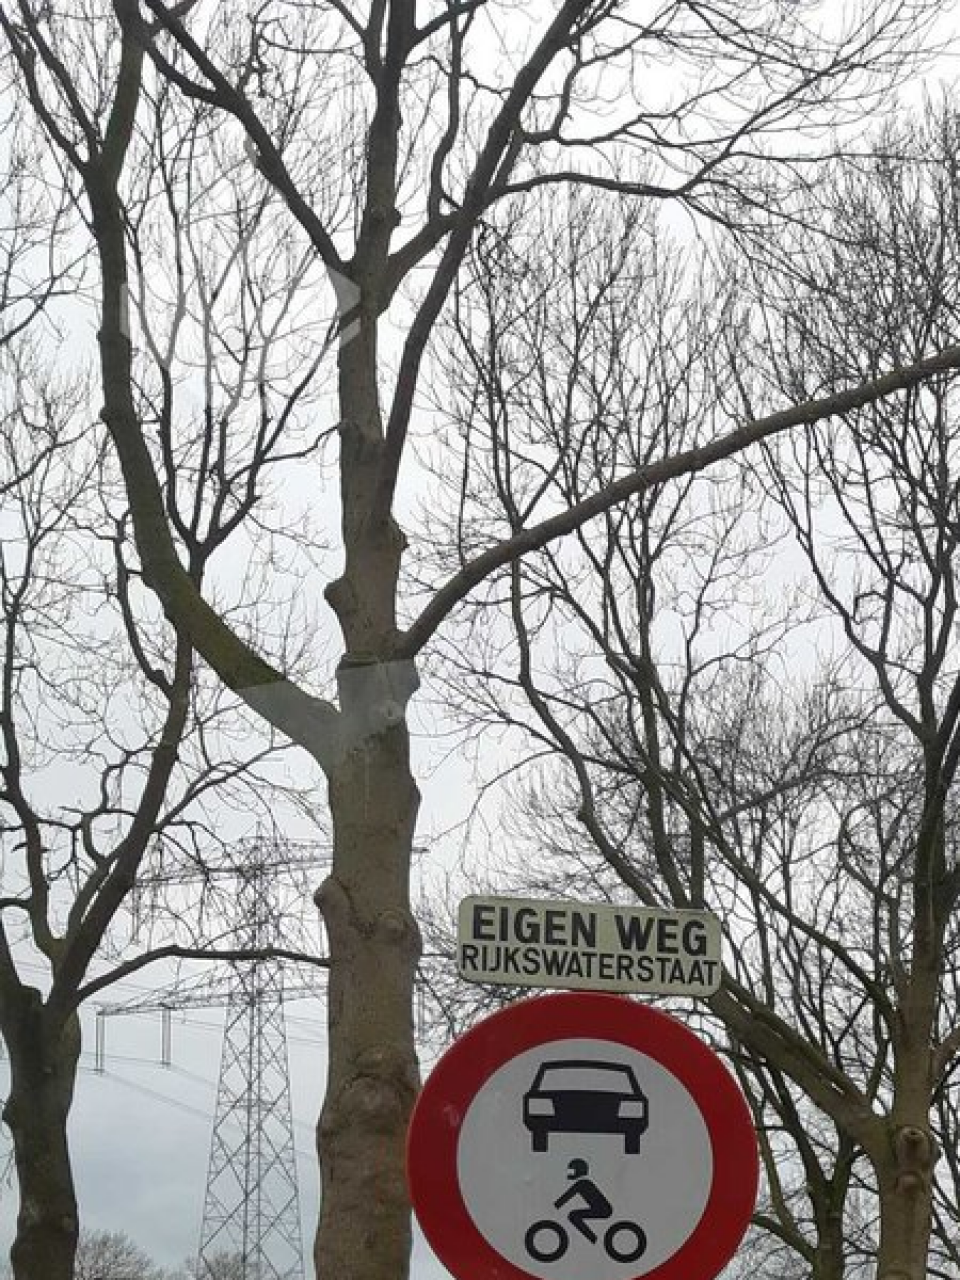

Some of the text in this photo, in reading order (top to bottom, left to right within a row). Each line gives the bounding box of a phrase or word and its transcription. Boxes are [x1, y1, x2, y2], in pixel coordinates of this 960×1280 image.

[473, 904, 707, 957] EIGEN WEG
[461, 944, 718, 987] RIJKSWATERSTAAT
